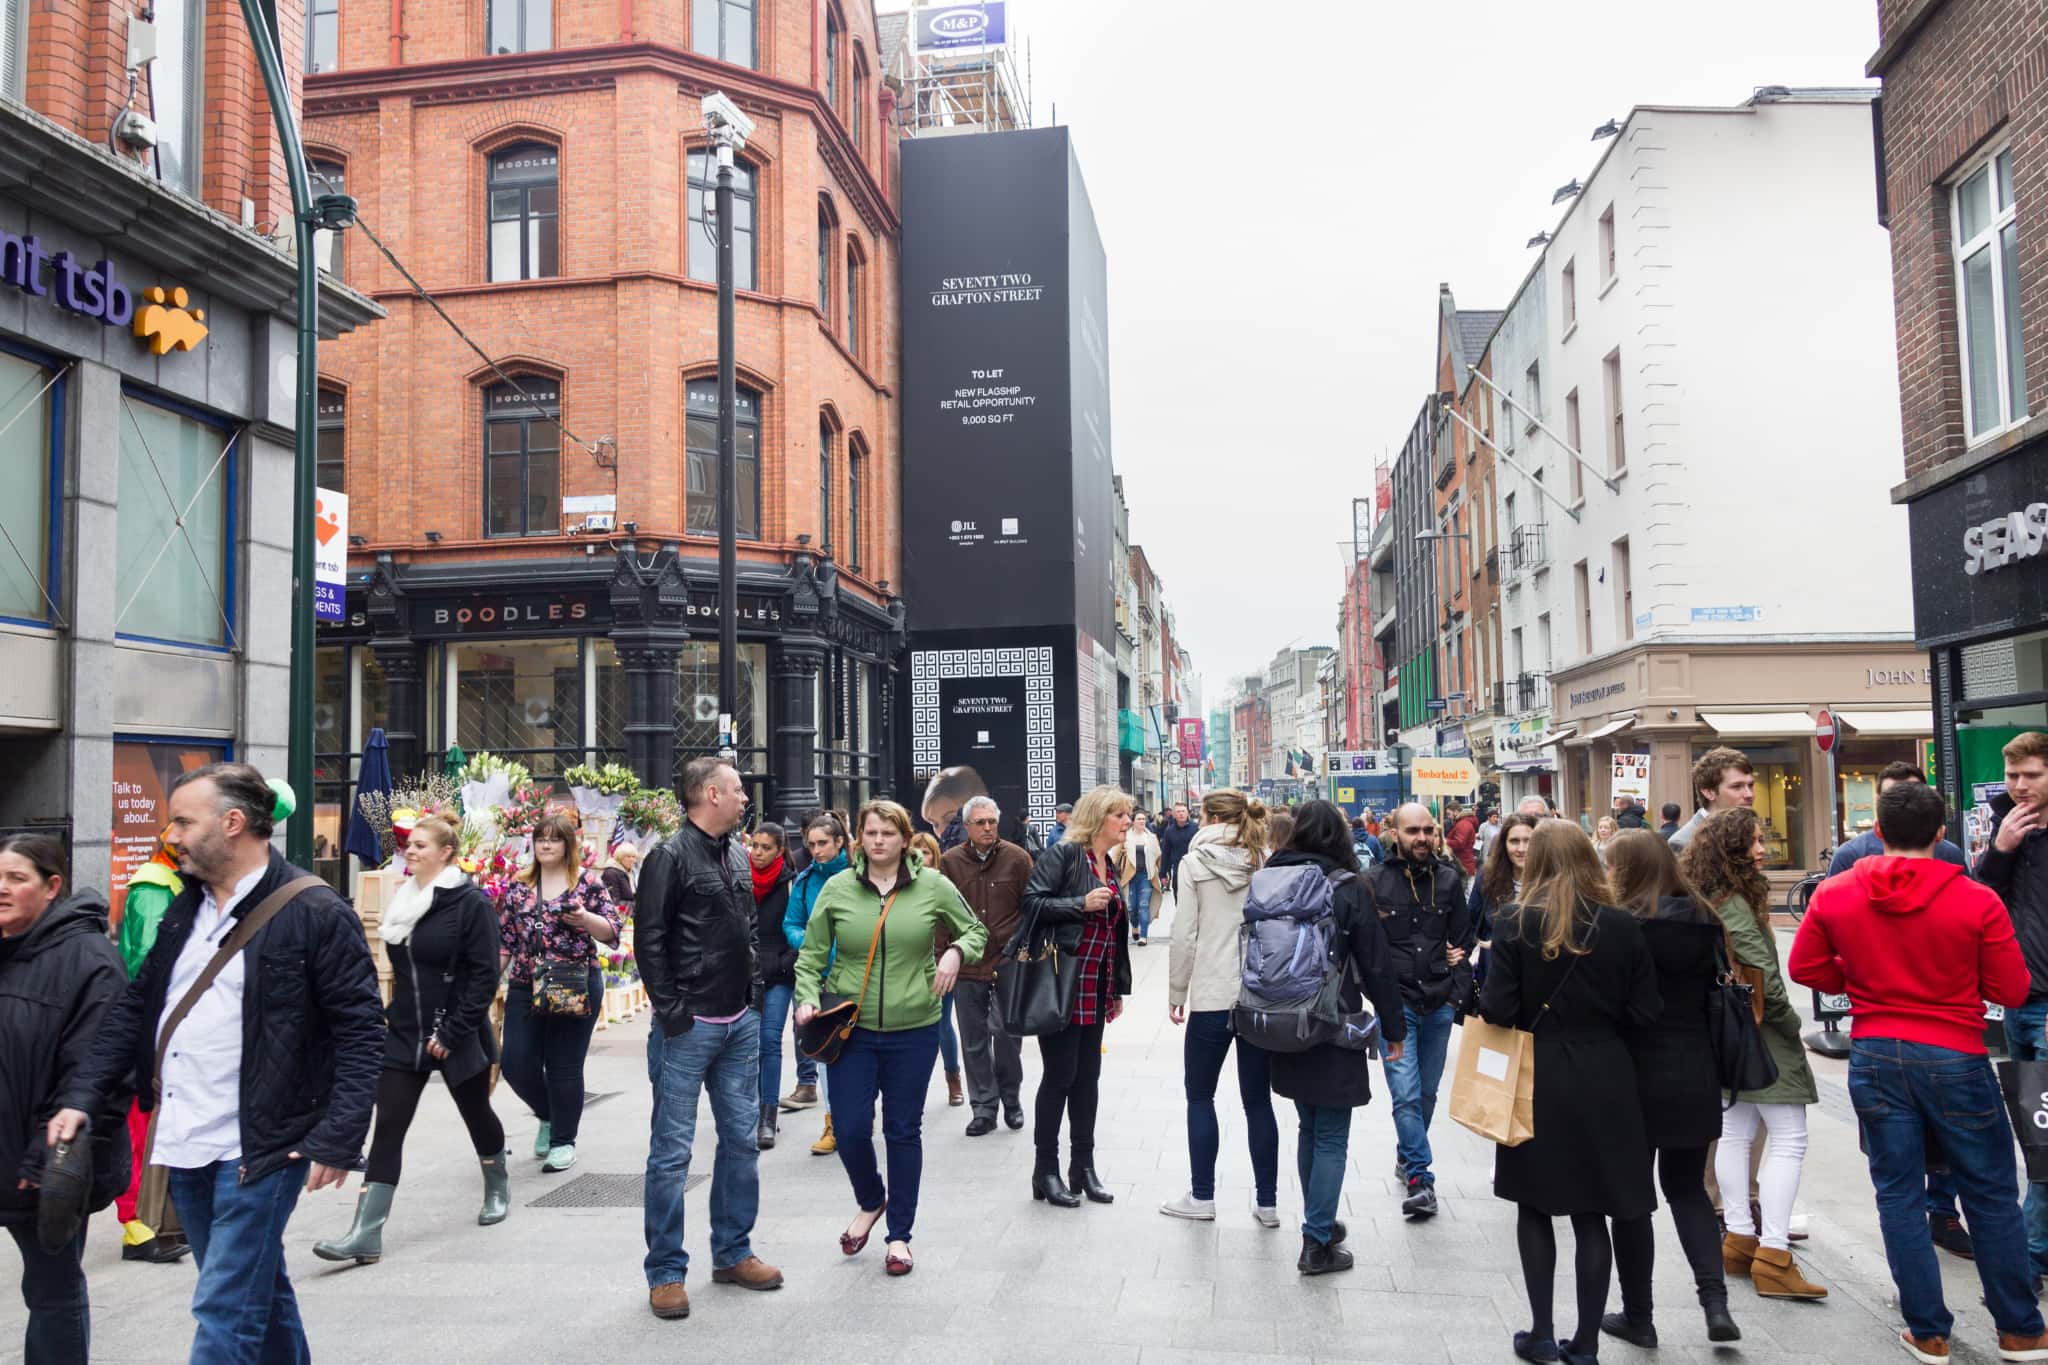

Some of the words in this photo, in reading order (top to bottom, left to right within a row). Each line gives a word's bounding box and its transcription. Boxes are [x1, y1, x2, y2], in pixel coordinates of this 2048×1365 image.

[942, 16, 979, 31] M&P
[942, 275, 999, 290] SEVENTY
[1000, 273, 1032, 287] TWO
[52, 252, 134, 326] tsb
[932, 291, 992, 306] GRAFTON
[993, 288, 1042, 303] STREET
[972, 370, 985, 379] TO
[987, 369, 1004, 378] LET
[955, 389, 976, 398] NEW
[977, 386, 1021, 397] FLAGSHIP
[690, 391, 748, 408] BOOES
[940, 399, 971, 409] RETAIL
[972, 396, 1036, 408] OPPORTUNITY
[962, 415, 987, 425] 9,000
[988, 414, 1001, 424] SQ
[1002, 414, 1014, 423] FT
[328, 589, 335, 600] &
[434, 603, 587, 624] BOODLES
[686, 604, 780, 621] BOLES
[1865, 667, 1918, 689] JOHN
[958, 698, 989, 706] SEVENTY
[953, 706, 986, 714] GRAFTON
[986, 705, 1013, 713] STREET
[1416, 769, 1459, 780] Timberland
[113, 782, 131, 794] Talk
[132, 784, 142, 794] to
[118, 800, 129, 809] us
[131, 798, 155, 811] today
